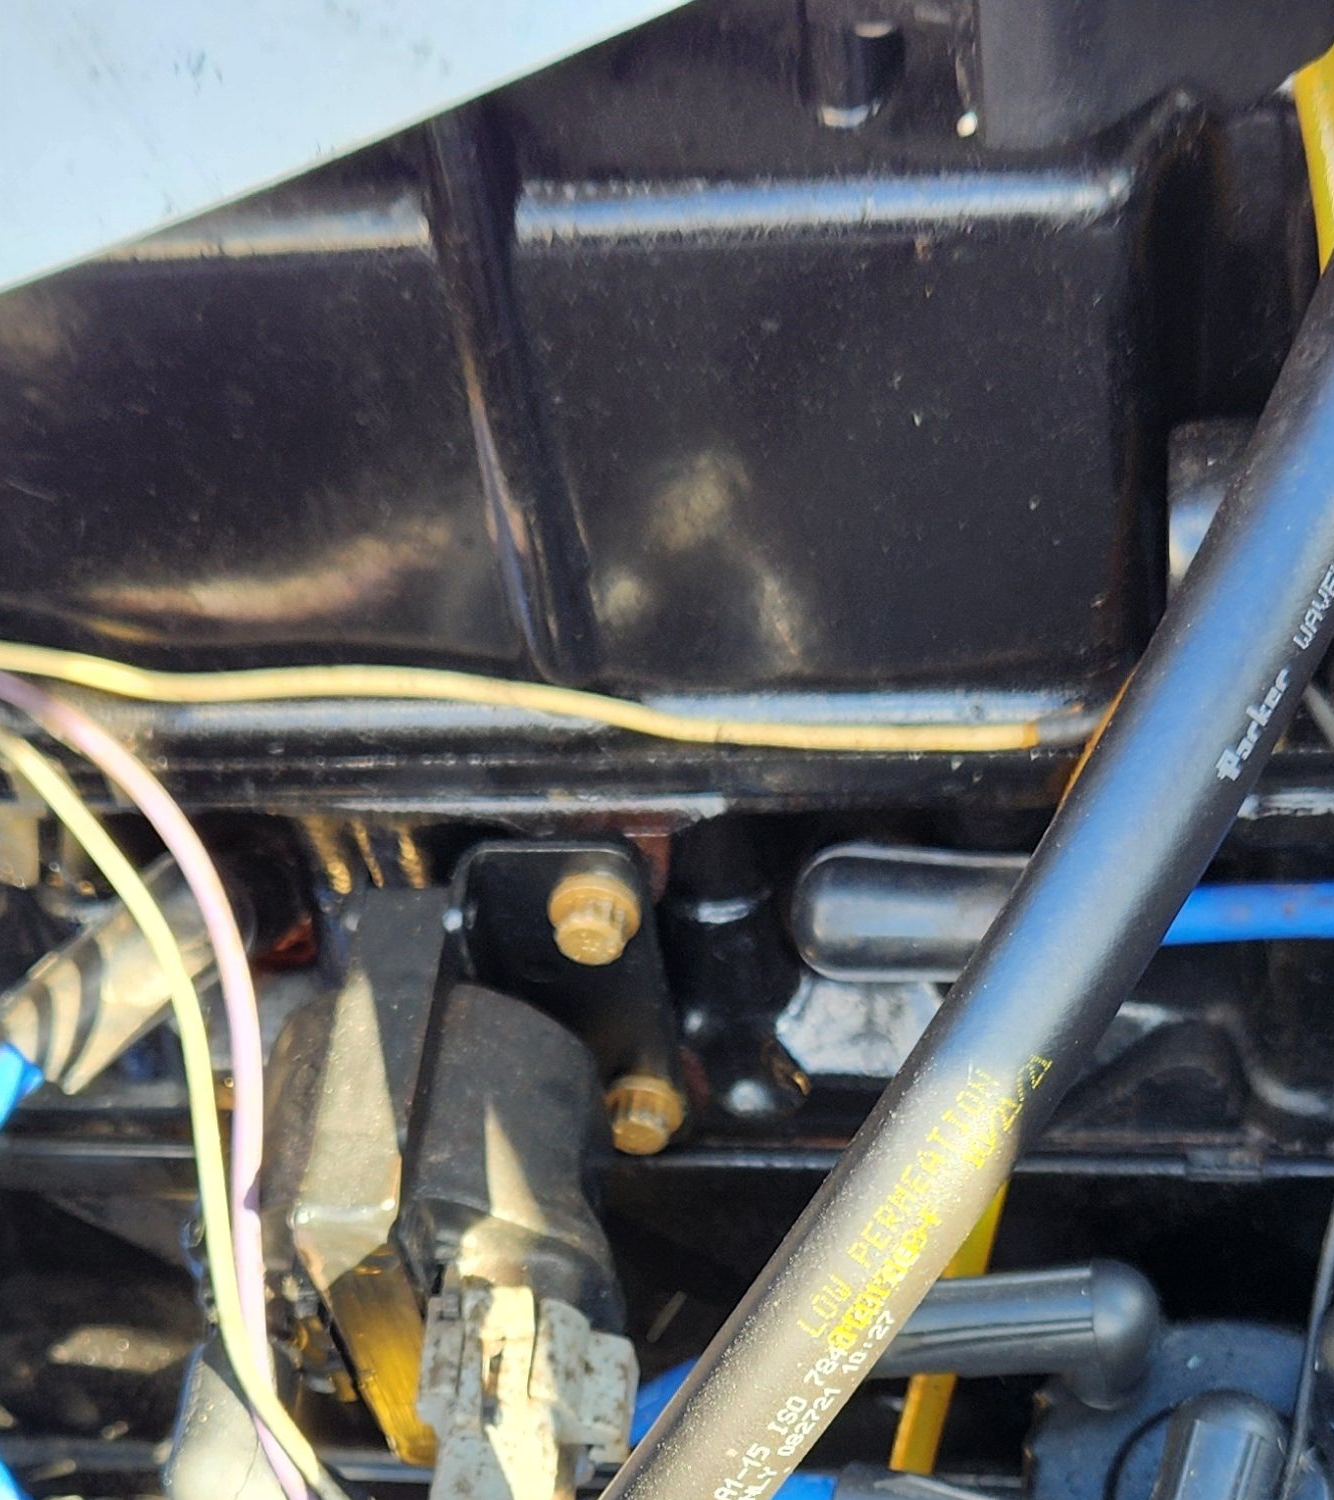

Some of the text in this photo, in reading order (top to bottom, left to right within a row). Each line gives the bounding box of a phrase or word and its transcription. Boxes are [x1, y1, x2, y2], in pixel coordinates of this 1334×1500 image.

[1216, 666, 1291, 782] Parker
[797, 1273, 854, 1338] LOW
[847, 1067, 1001, 1267] PERMEATION
[766, 1394, 809, 1437] ISO
[777, 1386, 842, 1459] 082721
[840, 1309, 896, 1376] 10:27
